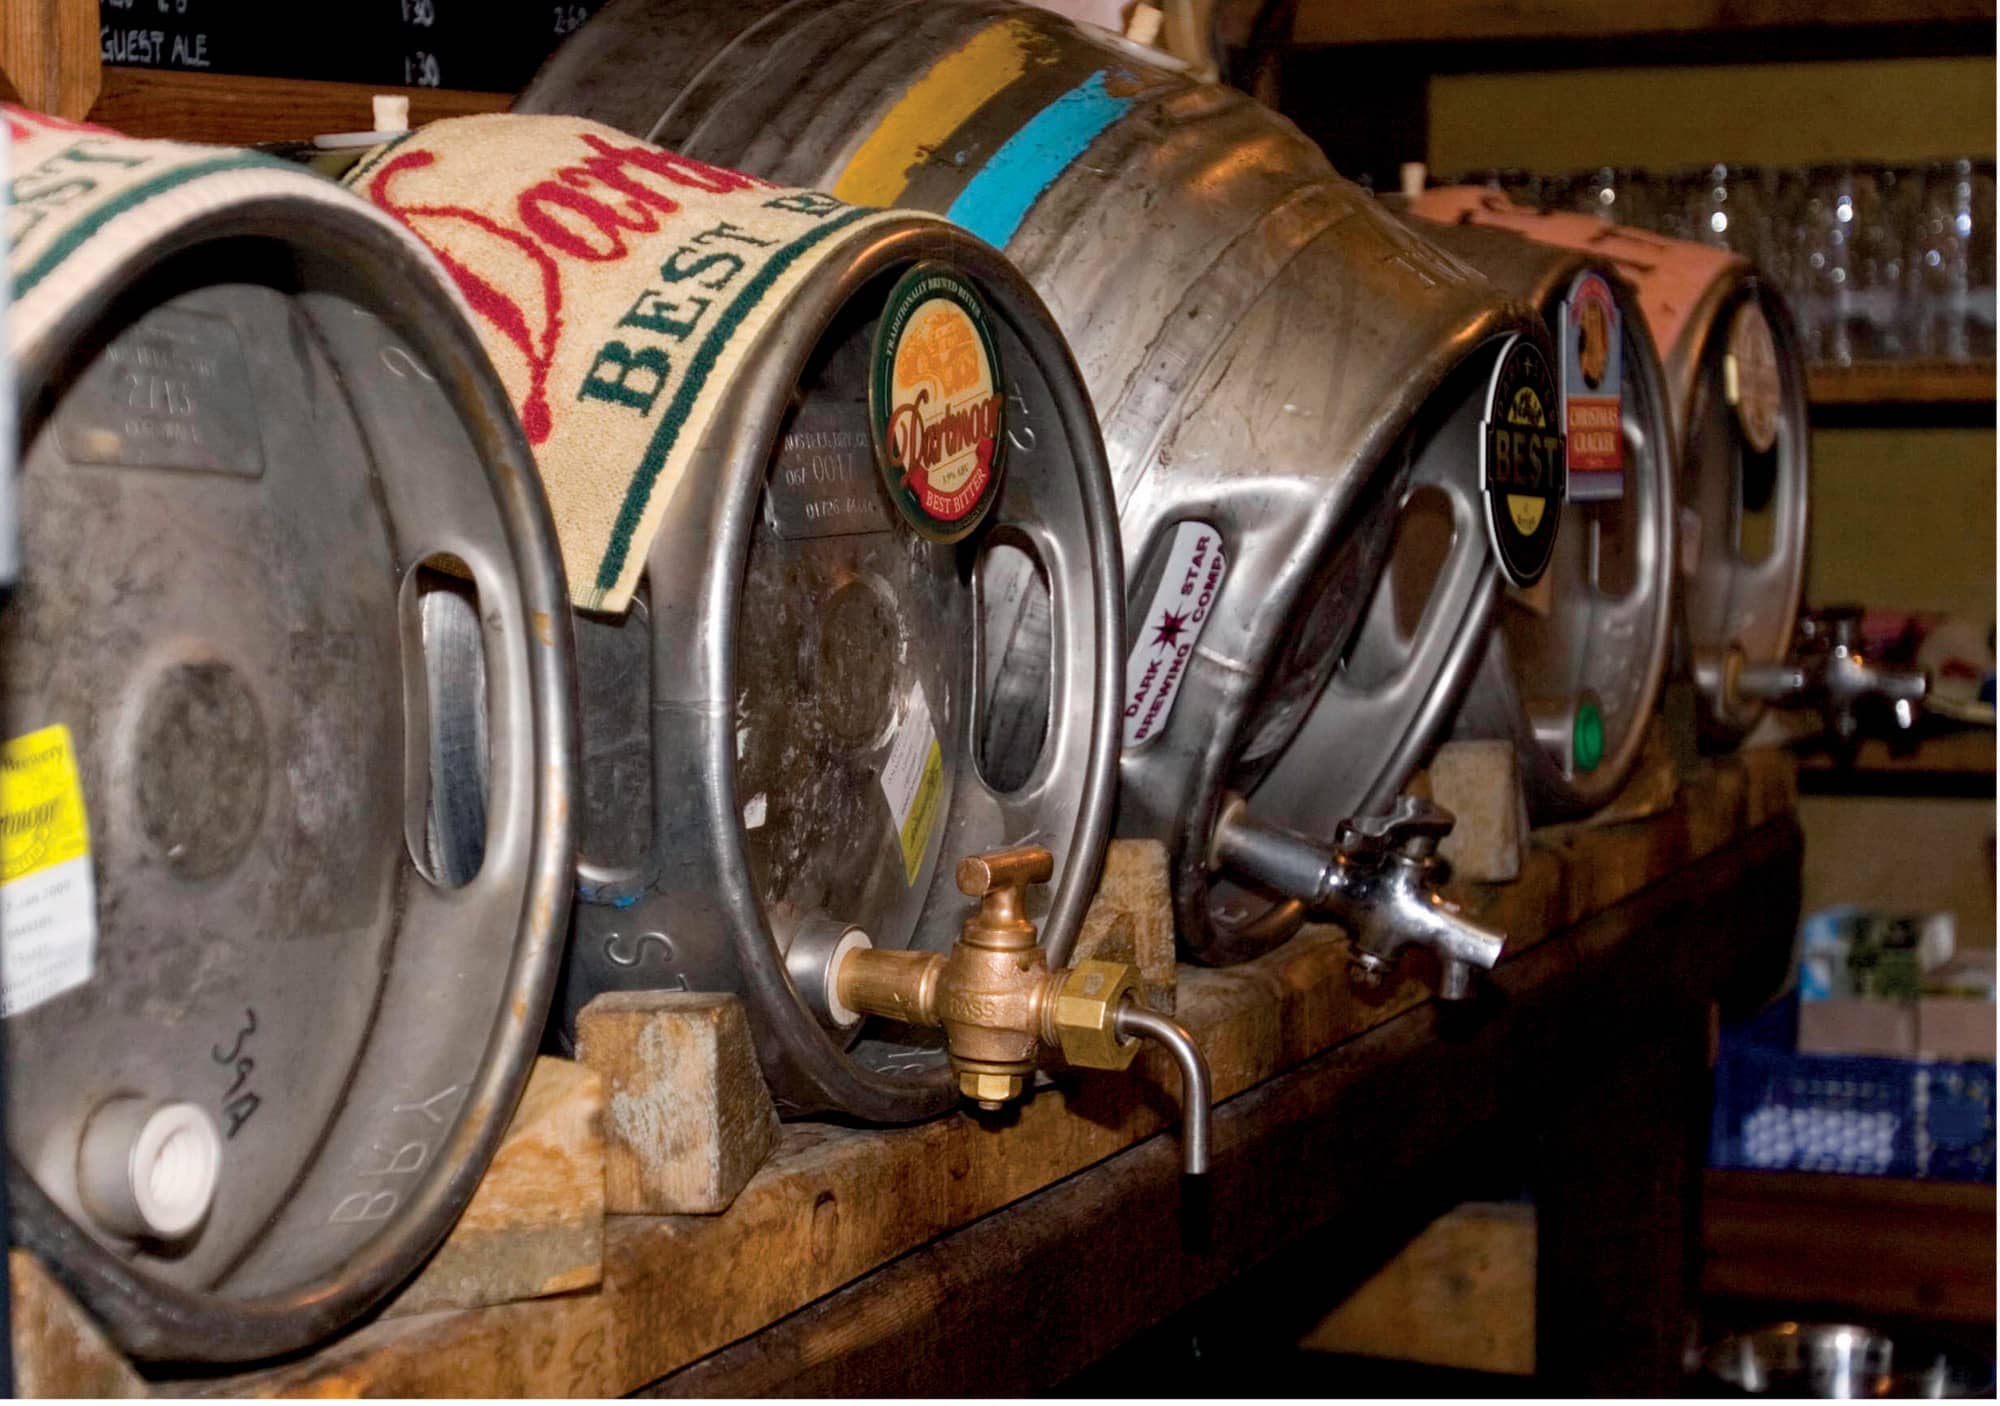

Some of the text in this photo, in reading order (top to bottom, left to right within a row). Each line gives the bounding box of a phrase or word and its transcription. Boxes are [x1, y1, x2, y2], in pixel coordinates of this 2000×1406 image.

[100, 25, 165, 64] GUEST
[171, 34, 211, 67] ALE
[577, 221, 779, 416] BEST
[886, 388, 1003, 487] Dartmoor
[1495, 429, 1560, 492] BEST
[925, 491, 952, 514] BEST
[953, 467, 988, 513] BITTER
[1124, 534, 1211, 720] DARK STAR
[1132, 641, 1193, 741] BREWING
